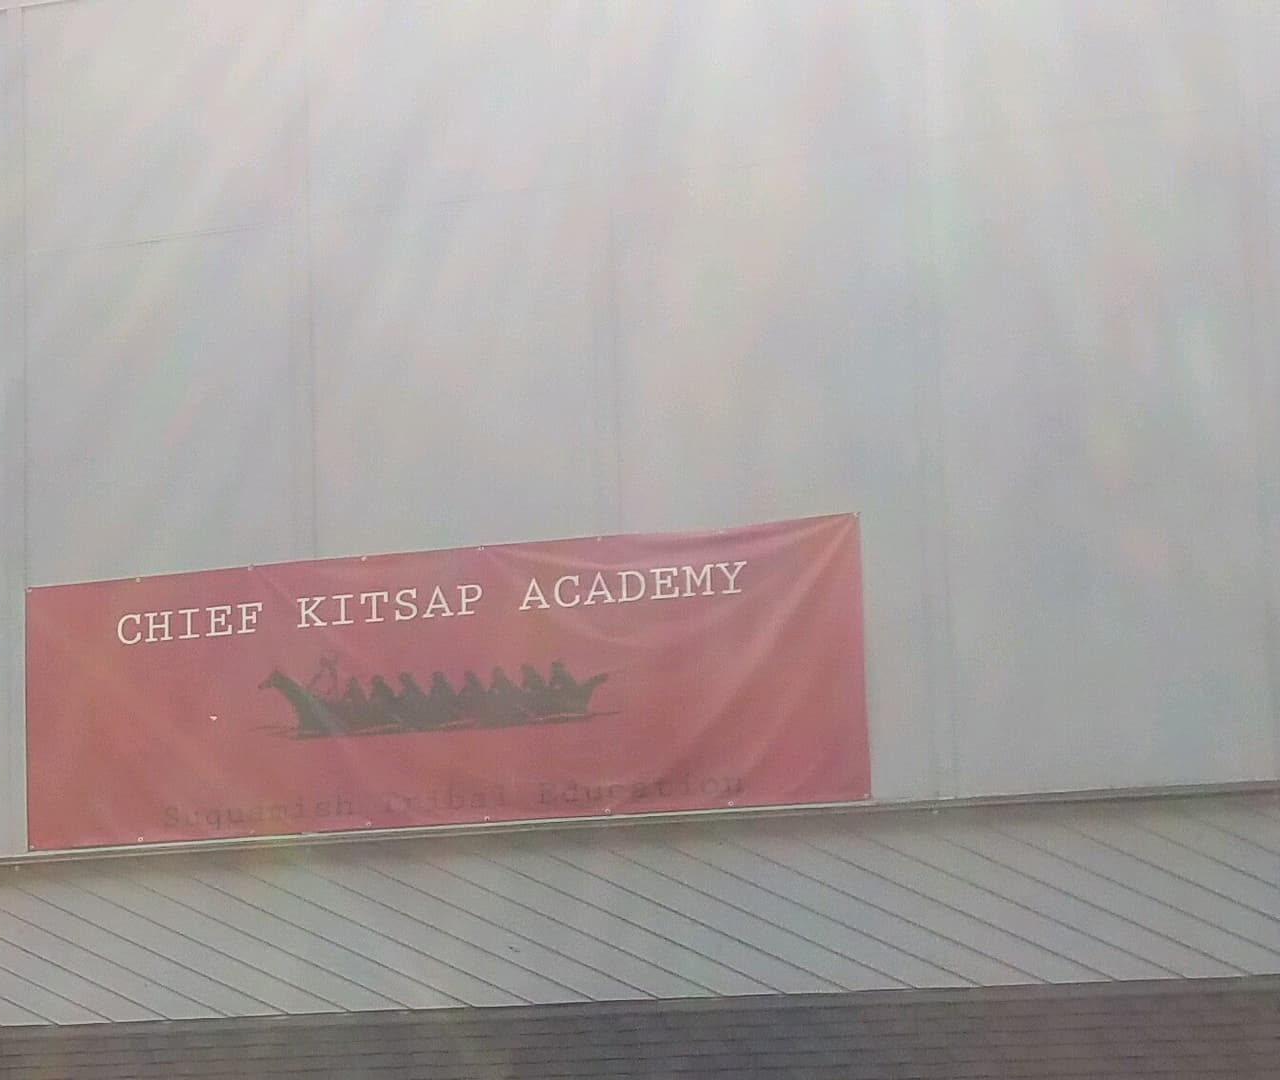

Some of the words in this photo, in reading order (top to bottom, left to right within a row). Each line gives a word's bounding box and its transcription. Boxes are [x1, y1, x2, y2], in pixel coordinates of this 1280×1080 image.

[116, 602, 264, 645] CHIEF
[296, 584, 485, 629] KITSAP
[518, 560, 748, 612] ACADEMY
